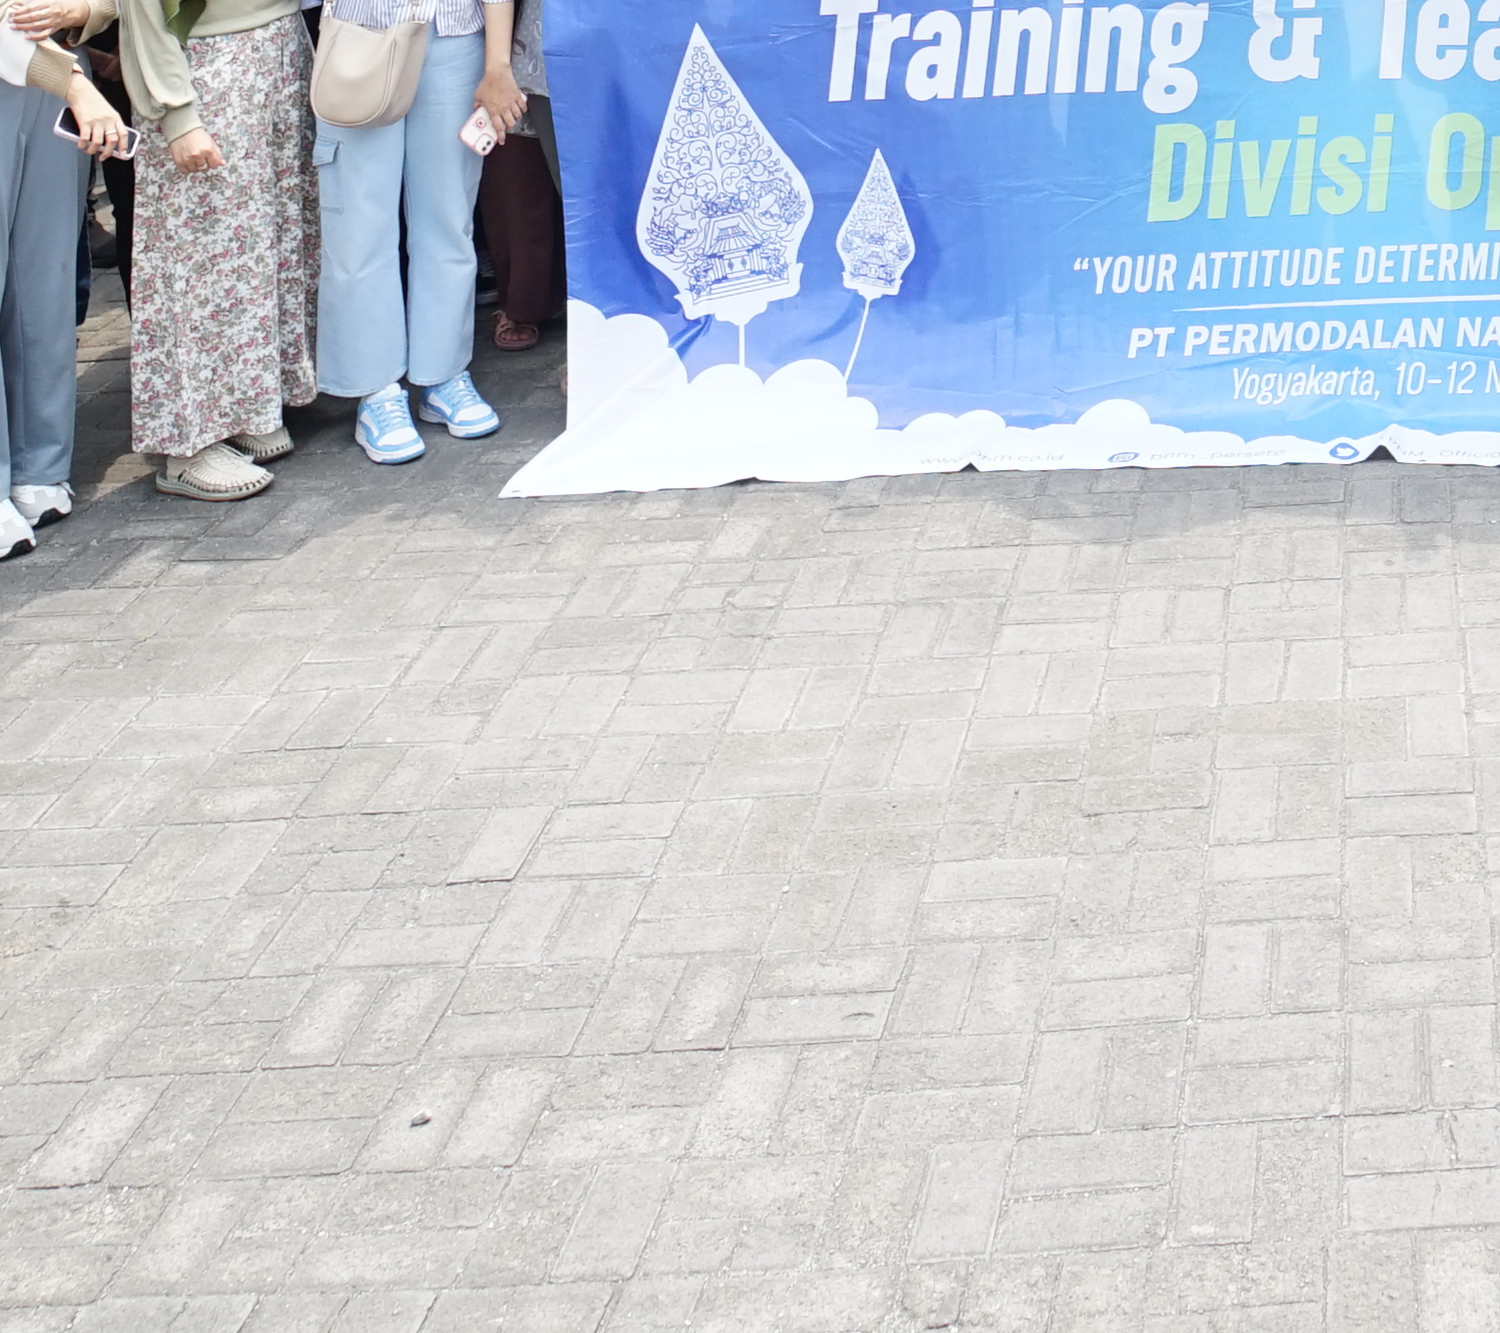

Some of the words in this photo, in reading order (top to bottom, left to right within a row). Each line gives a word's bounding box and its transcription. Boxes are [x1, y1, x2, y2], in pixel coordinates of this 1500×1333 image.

[1146, 113, 1395, 224] Divisi
[1186, 246, 1346, 291] ATTITUDE
[1127, 326, 1176, 360] PT
[1182, 317, 1445, 357] PERMODALAN
[1231, 364, 1381, 406] Yogyakarta,
